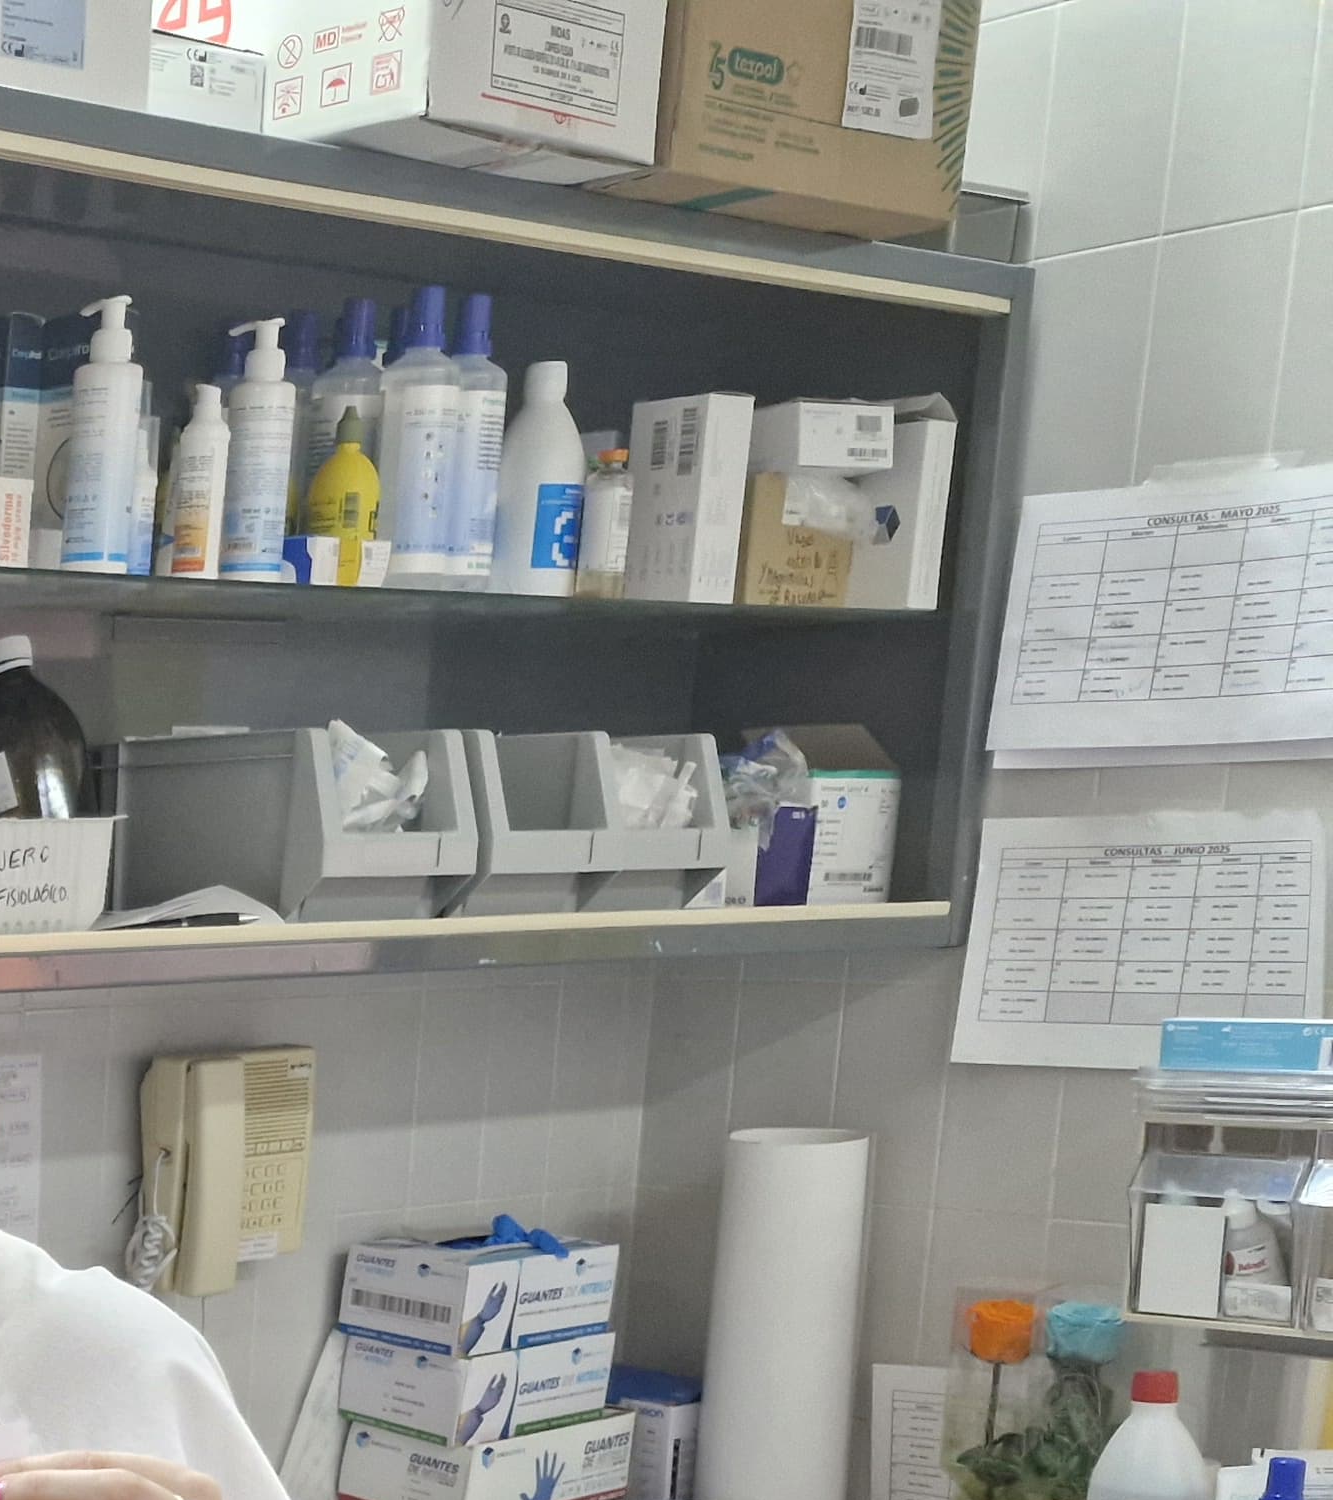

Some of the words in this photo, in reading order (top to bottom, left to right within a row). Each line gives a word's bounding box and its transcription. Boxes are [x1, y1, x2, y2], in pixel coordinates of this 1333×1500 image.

[316, 31, 337, 51] MD
[735, 52, 777, 80] texpol
[1147, 511, 1210, 527] CONSULTAS
[1220, 507, 1254, 520] MAYO
[1256, 504, 1281, 516] 2025
[1103, 846, 1163, 857] CONSULTAS
[1173, 845, 1205, 856] JUNIO
[1206, 844, 1231, 856] 2025
[356, 1252, 396, 1269] GUANTES
[519, 1287, 563, 1305] GUANTES
[355, 1342, 395, 1358] GUANTES
[518, 1376, 561, 1396] GUANTES
[584, 1430, 631, 1455] GUANTES
[408, 1453, 460, 1475] GUANTES
